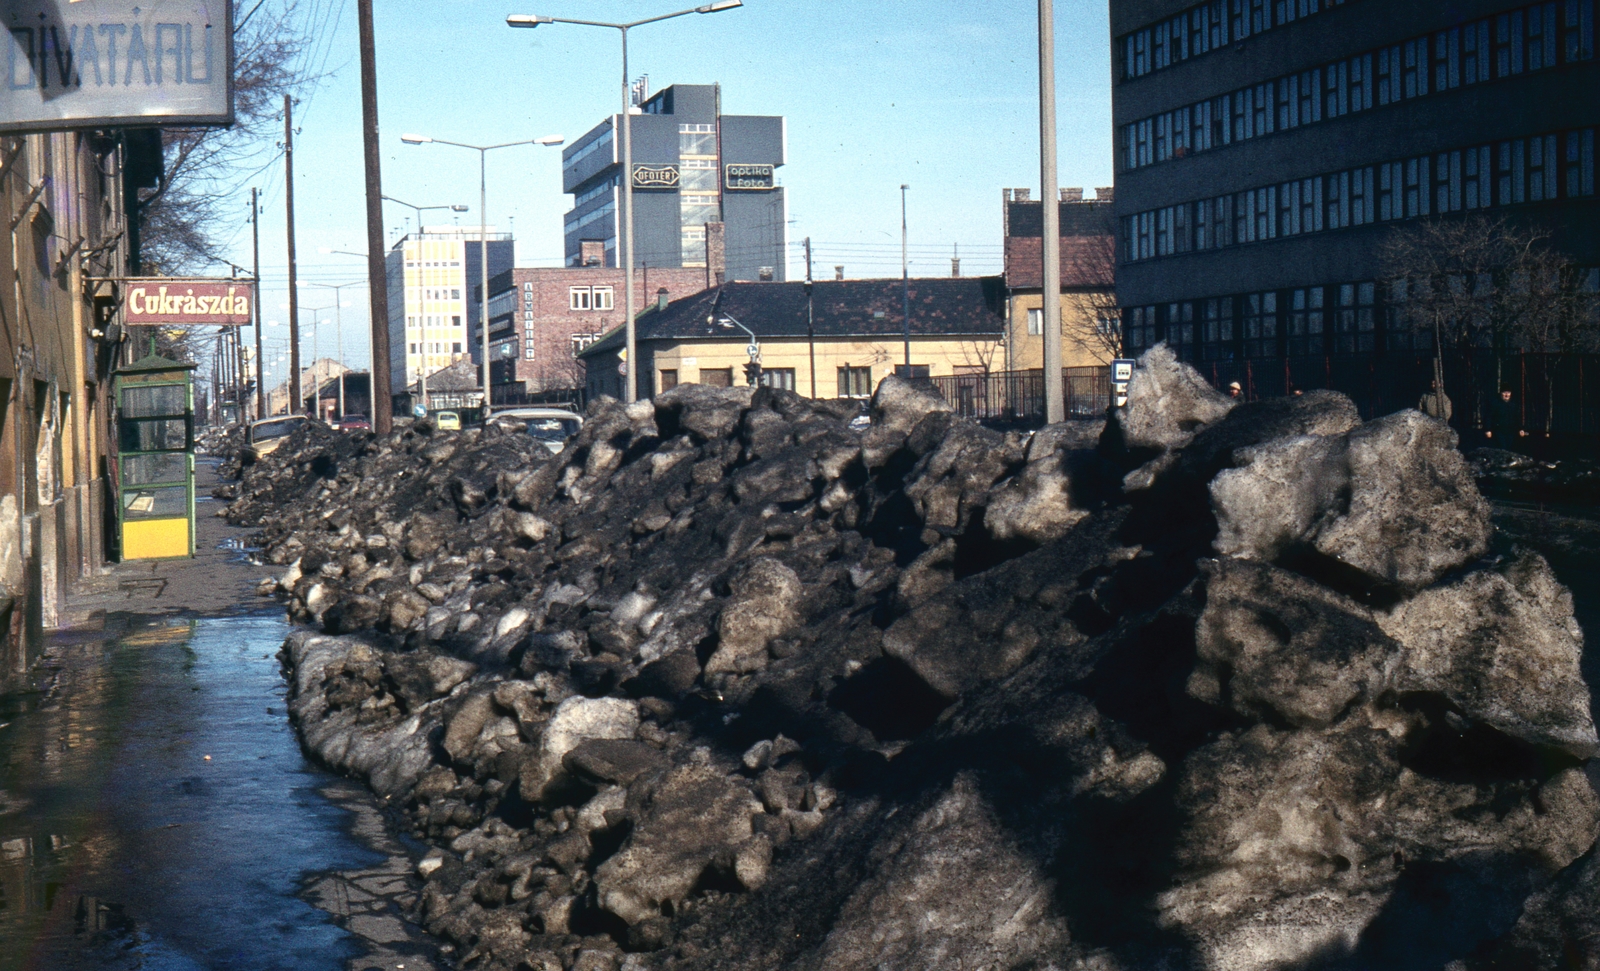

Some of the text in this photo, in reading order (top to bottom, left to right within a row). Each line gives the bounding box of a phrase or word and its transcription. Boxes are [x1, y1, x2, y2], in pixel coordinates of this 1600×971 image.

[731, 166, 770, 178] optika
[737, 178, 765, 188] foto
[129, 286, 249, 315] Cukrászda
